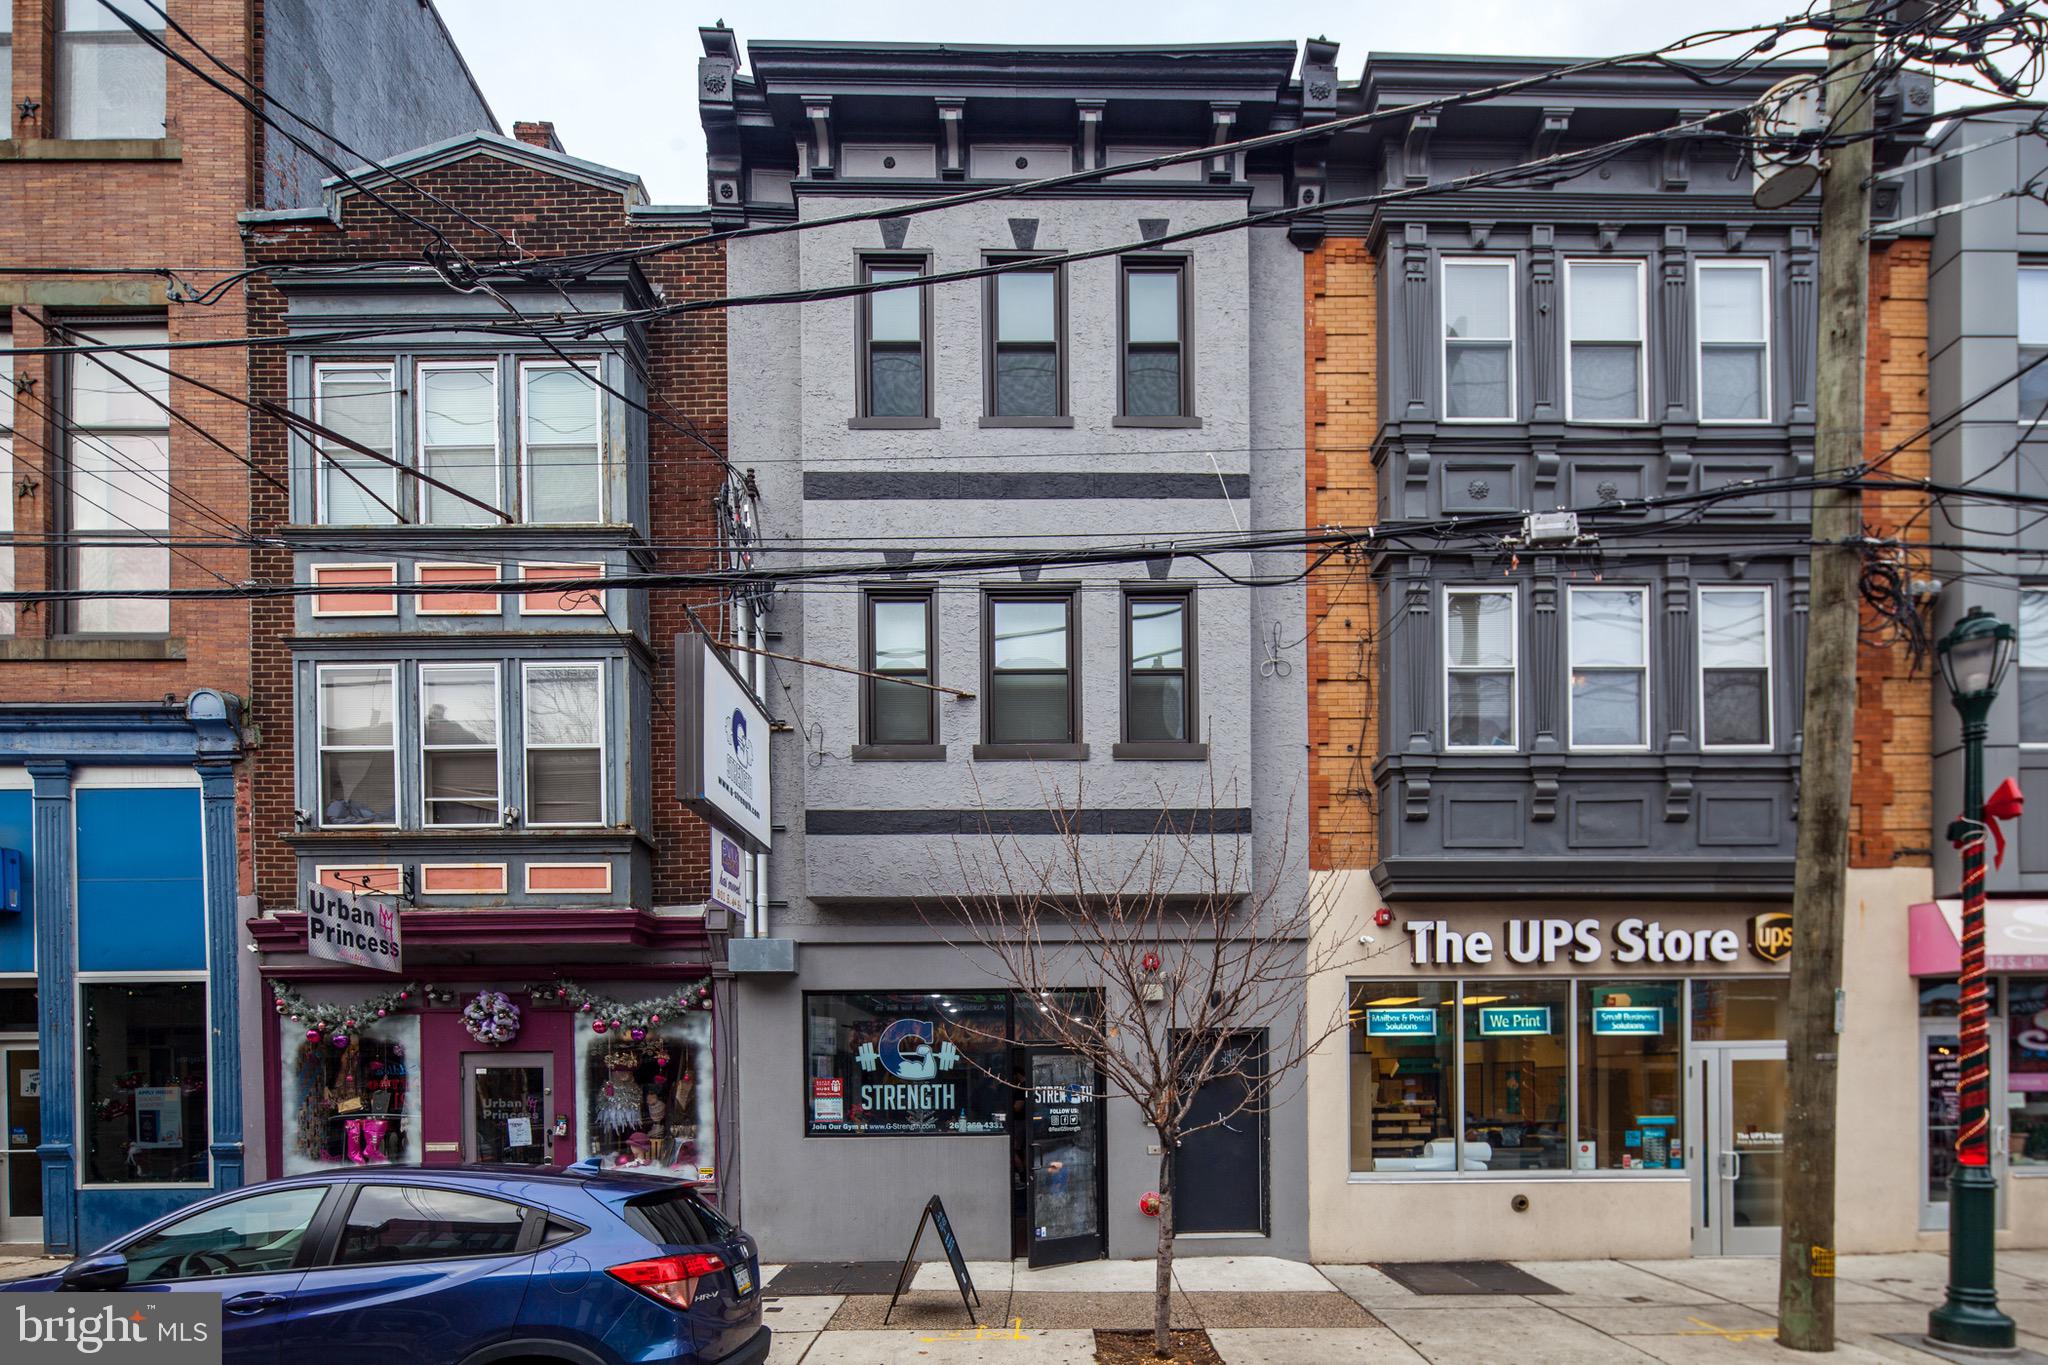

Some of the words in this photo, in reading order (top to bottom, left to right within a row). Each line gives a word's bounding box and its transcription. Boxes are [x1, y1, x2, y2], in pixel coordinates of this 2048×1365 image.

[310, 889, 375, 928] Urban
[310, 916, 399, 957] Princess
[1407, 919, 1494, 964] The
[1507, 918, 1602, 964] UPS
[1615, 918, 1740, 963] Store
[1758, 924, 1793, 954] ups
[1371, 1013, 1400, 1023] Mailbox
[1409, 1013, 1431, 1022] Postal
[1489, 1014, 1510, 1028] We
[1512, 1014, 1541, 1027] Print
[1601, 1012, 1622, 1021] Small
[1385, 1023, 1418, 1031] Solutions
[1611, 1022, 1645, 1030] Solutions
[483, 1098, 522, 1109] Urban
[861, 1083, 956, 1111] STRENGTH
[842, 1123, 859, 1131] Gym
[869, 1122, 937, 1131] www.G-Strength.com
[694, 1290, 719, 1303] HR-V
